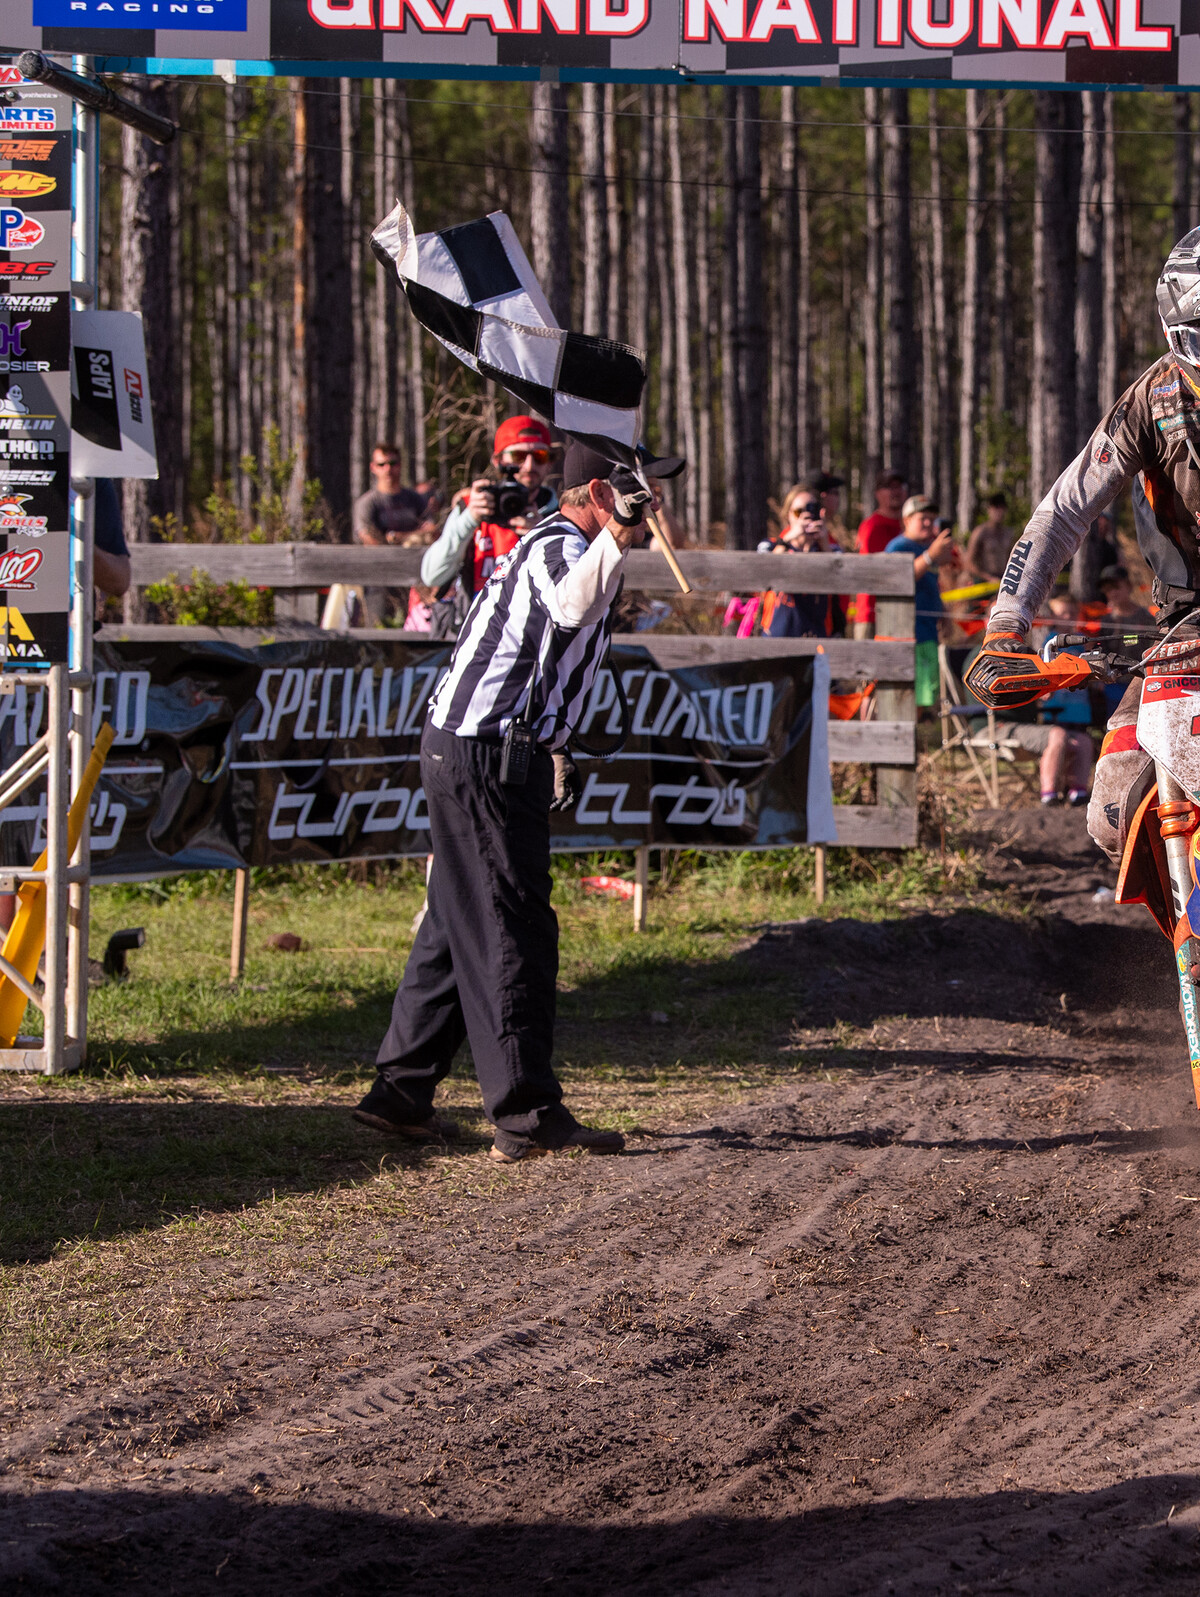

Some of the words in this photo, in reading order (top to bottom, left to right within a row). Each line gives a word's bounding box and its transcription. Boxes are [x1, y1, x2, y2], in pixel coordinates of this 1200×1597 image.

[70, 1, 215, 14] RACING
[682, 0, 1175, 51] NATIONAL
[88, 352, 113, 400] LAPS
[1001, 540, 1033, 596] THOR
